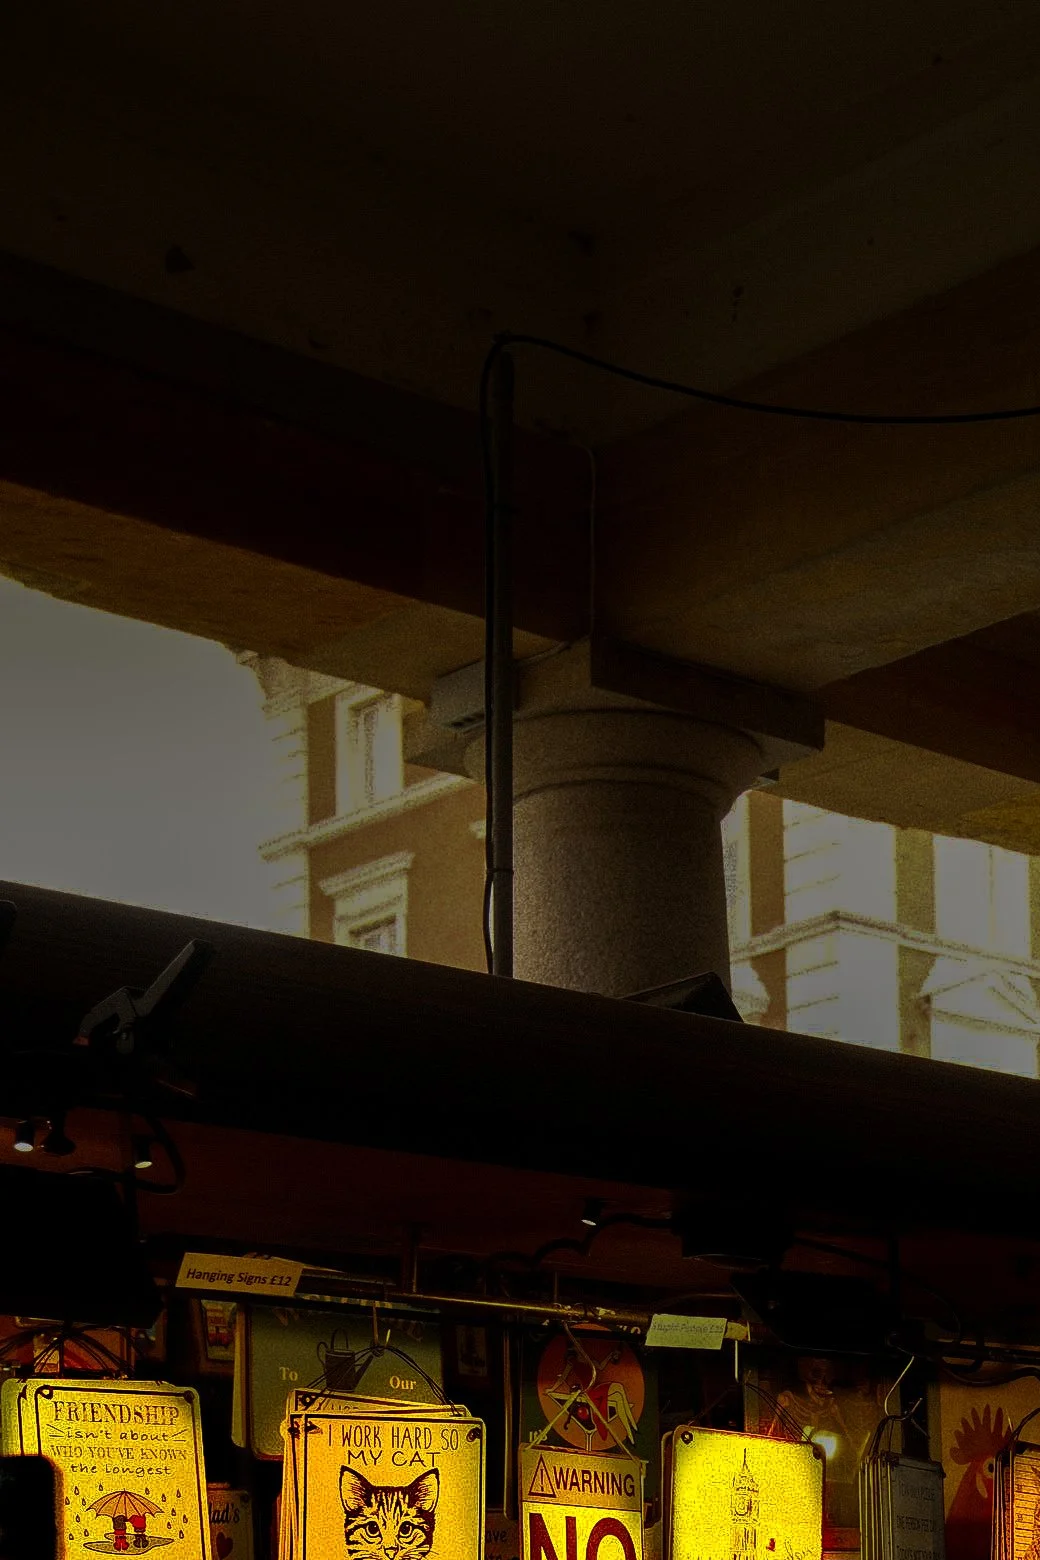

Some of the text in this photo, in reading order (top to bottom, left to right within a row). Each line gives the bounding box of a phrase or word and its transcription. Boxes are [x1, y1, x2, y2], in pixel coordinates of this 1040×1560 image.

[186, 1267, 292, 1287] Hanging Signs £12
[279, 1366, 299, 1382] To
[389, 1375, 417, 1391] Our
[53, 1400, 180, 1426] FRIENDSHIP
[66, 1429, 169, 1441] isn't about
[327, 1424, 459, 1451] I WORK HARD SO
[49, 1444, 188, 1460] WHO YOU'VE KNOWN
[347, 1450, 441, 1467] MY CAT
[70, 1463, 97, 1474] the
[552, 1466, 635, 1496] WARNING
